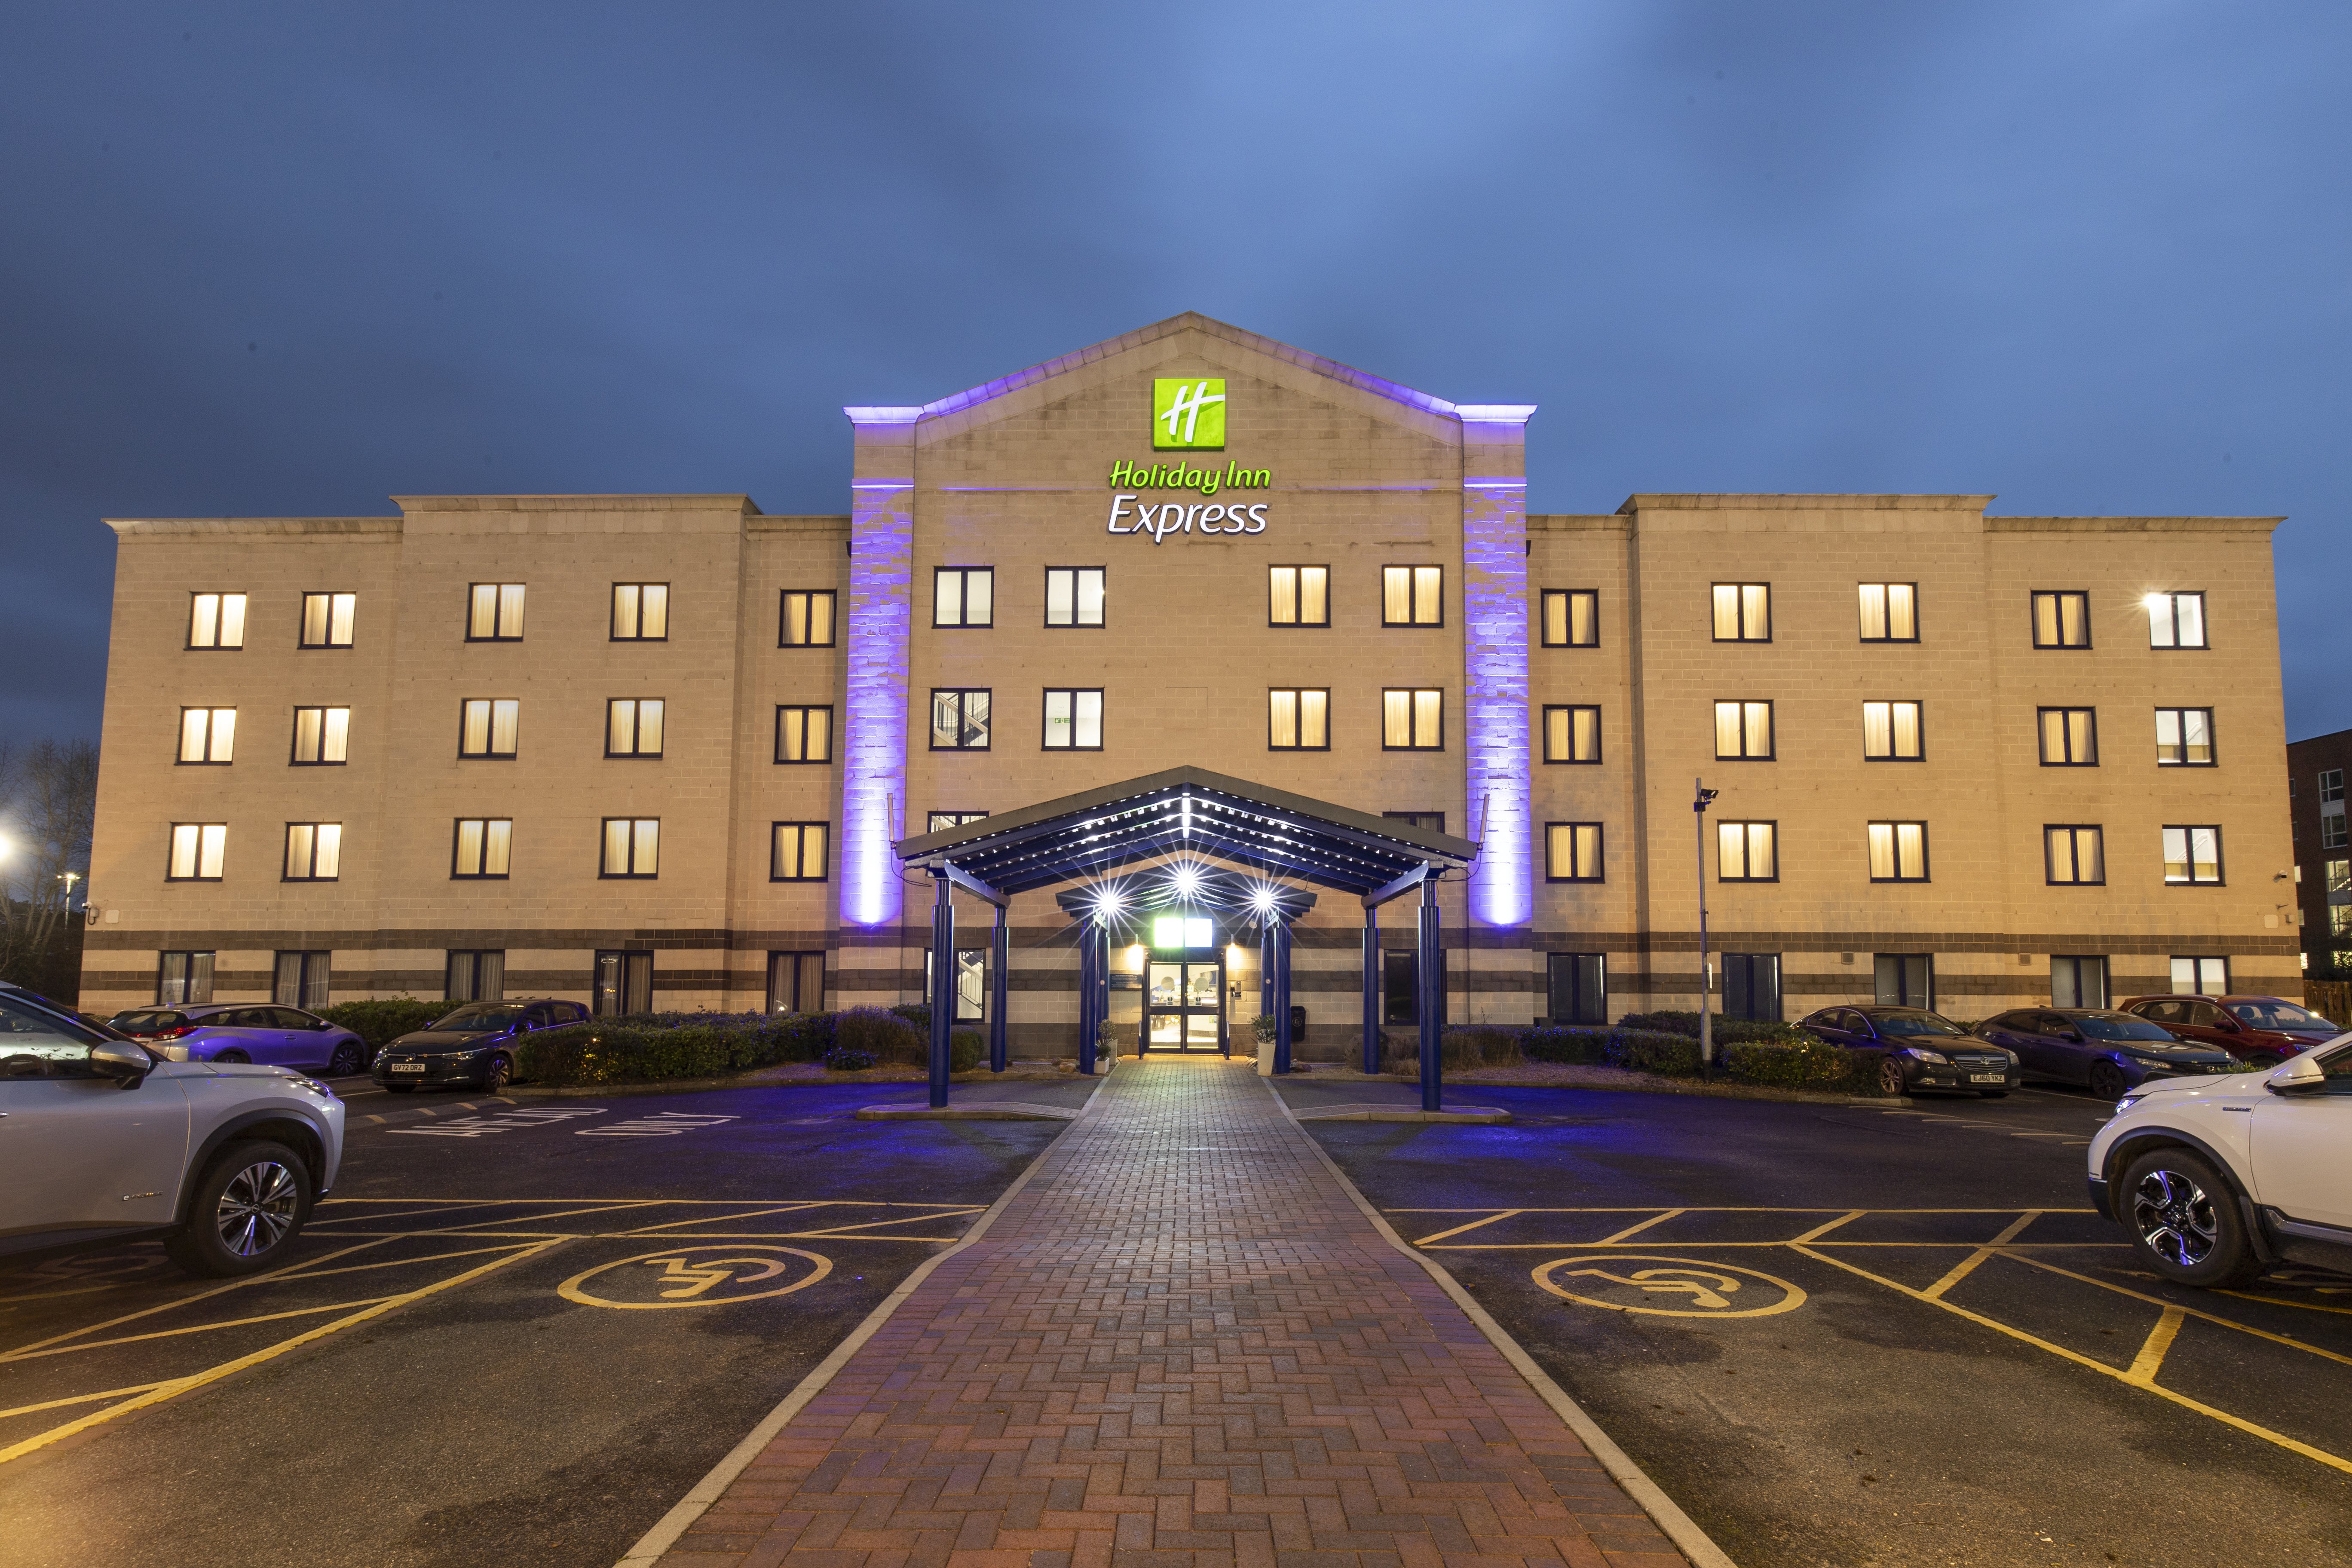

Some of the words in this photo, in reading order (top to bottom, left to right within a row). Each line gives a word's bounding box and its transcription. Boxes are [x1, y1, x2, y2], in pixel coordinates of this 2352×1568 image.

[1109, 460, 1221, 494] Holiday
[1226, 460, 1271, 487] Inn
[1108, 495, 1268, 545] Express
[386, 1108, 609, 1137] AHEAD
[575, 1112, 741, 1136] ONLY
